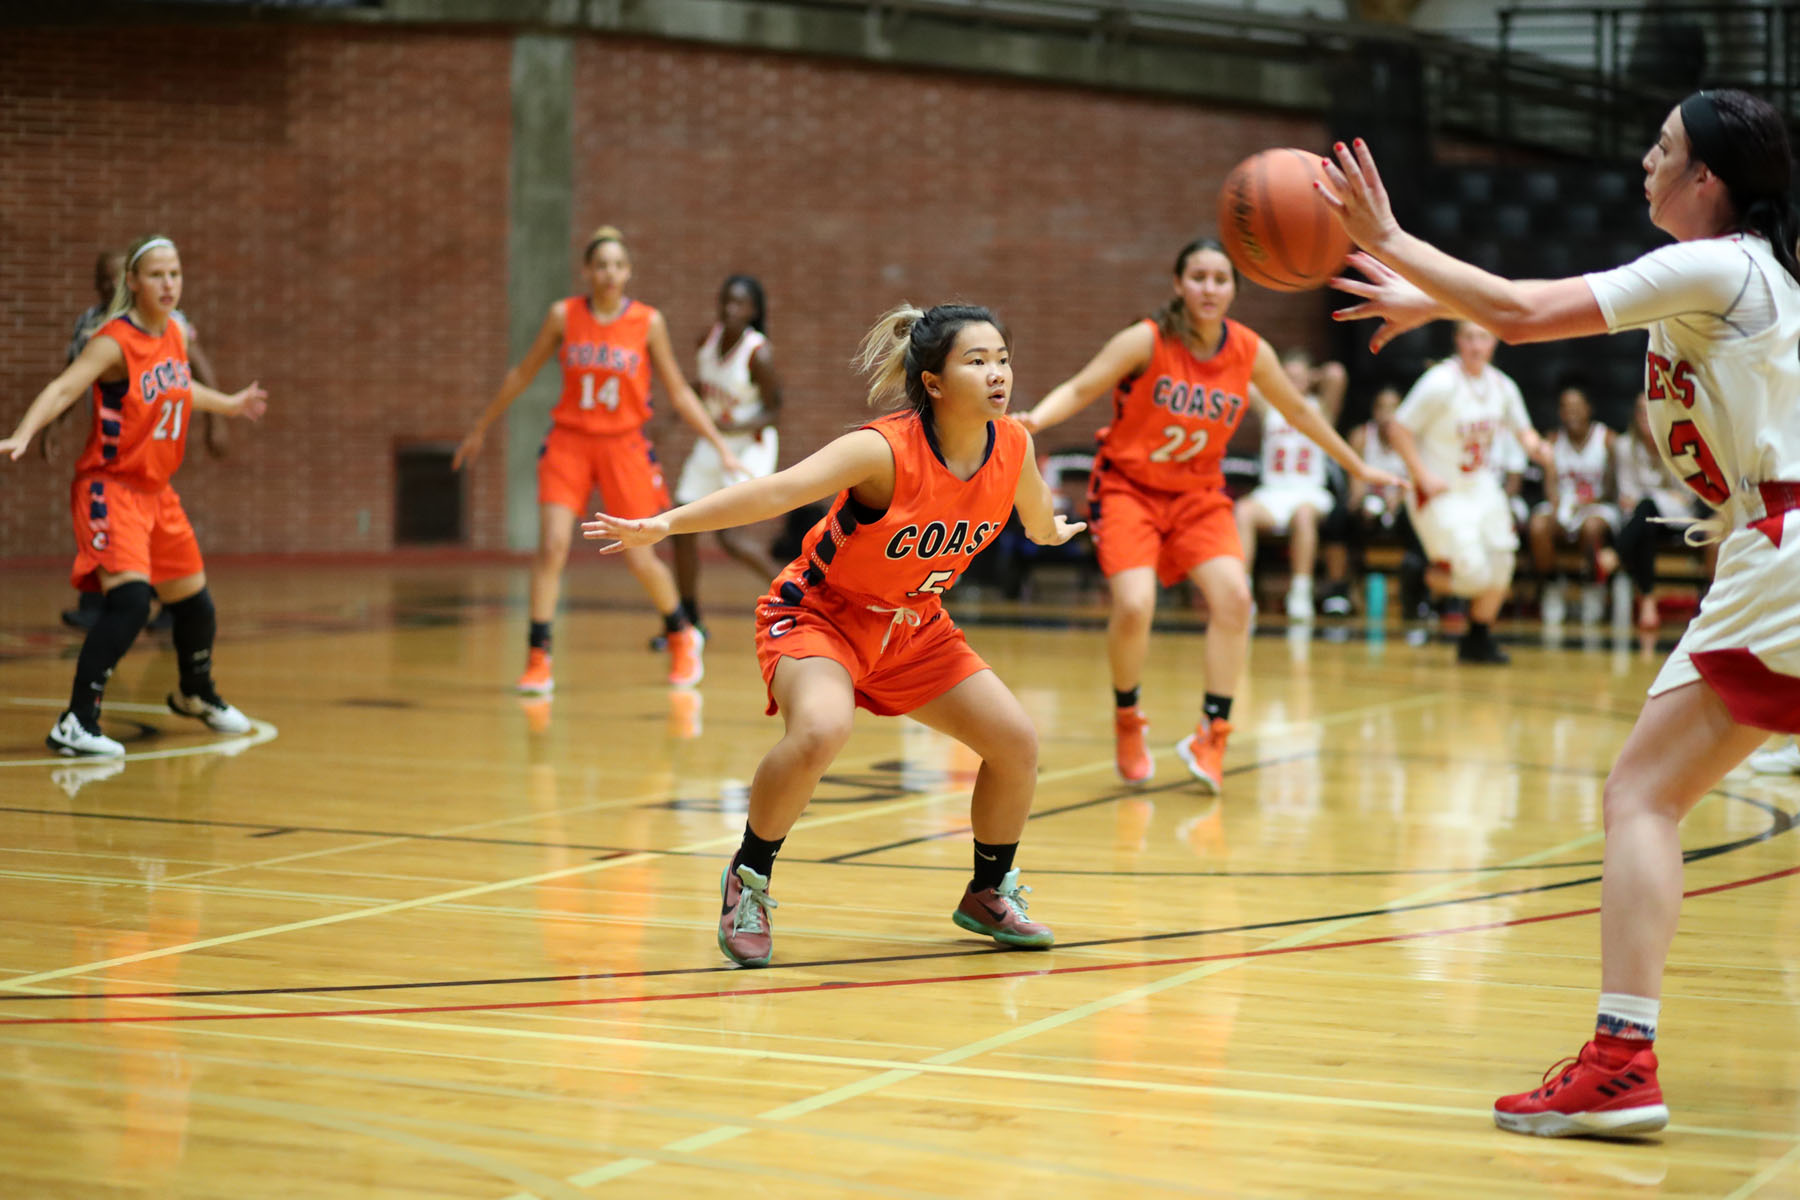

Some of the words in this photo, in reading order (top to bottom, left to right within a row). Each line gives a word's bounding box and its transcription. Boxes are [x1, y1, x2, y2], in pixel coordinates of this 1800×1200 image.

[580, 374, 620, 411] 14
[1154, 376, 1243, 426] COAST
[153, 400, 183, 440] 21
[1151, 426, 1209, 462] 22
[907, 569, 955, 597] 5
